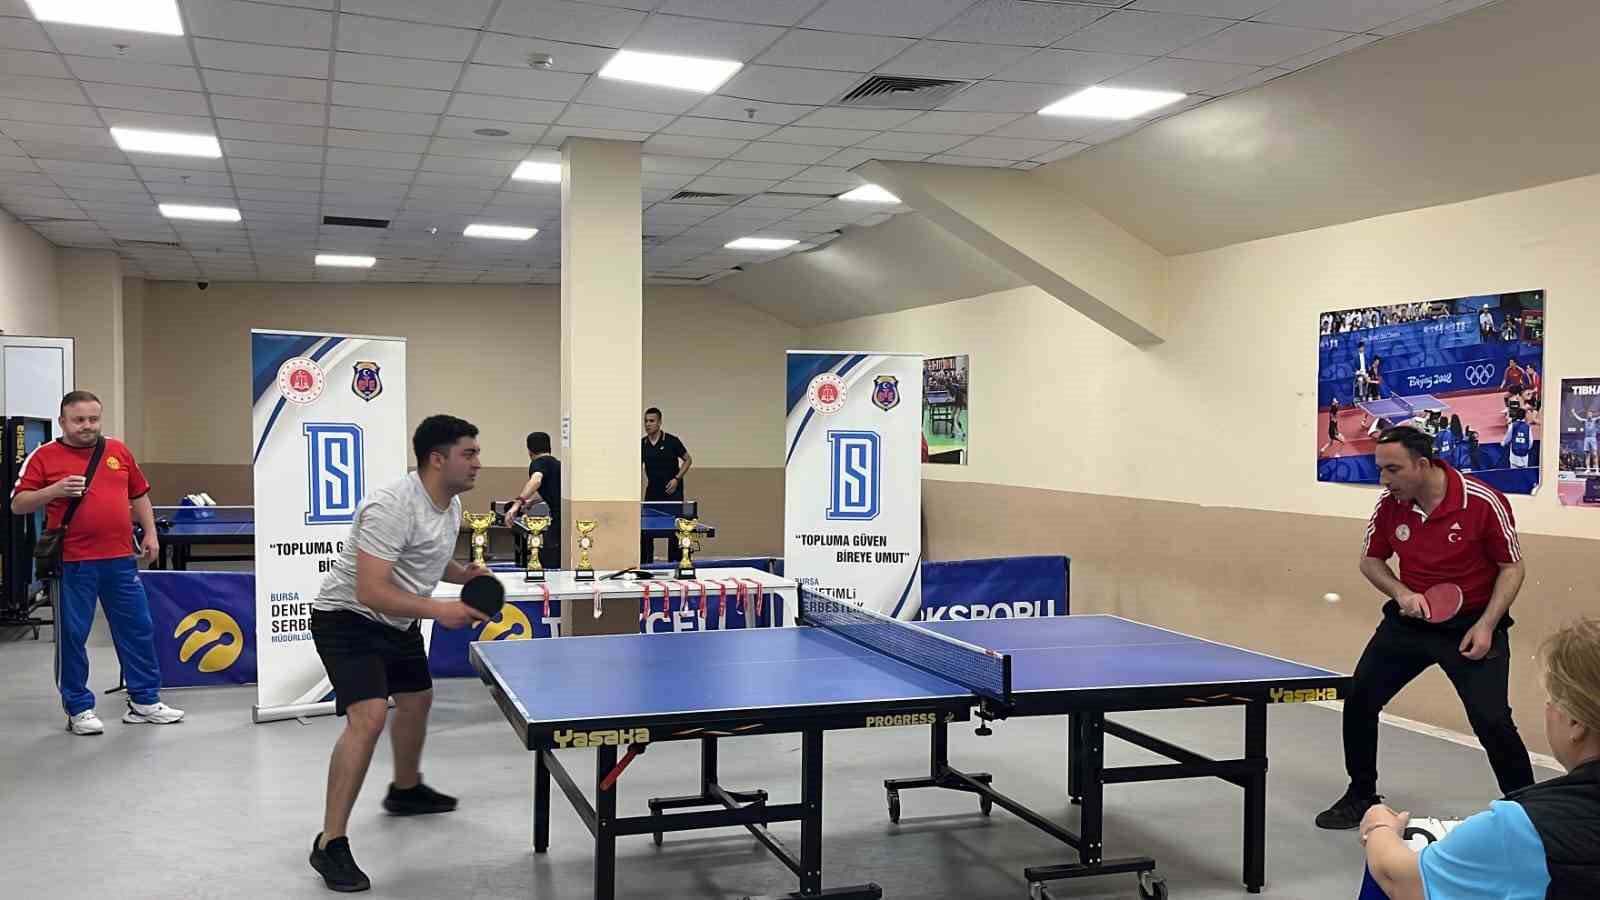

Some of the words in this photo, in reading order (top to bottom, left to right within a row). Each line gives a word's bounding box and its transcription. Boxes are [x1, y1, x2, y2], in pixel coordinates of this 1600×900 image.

[853, 533, 887, 547] GÜVEN
[836, 549, 872, 563] BİREYE
[271, 592, 299, 602] BURSA
[271, 602, 314, 618] DENET
[865, 713, 936, 728] PROGRESS
